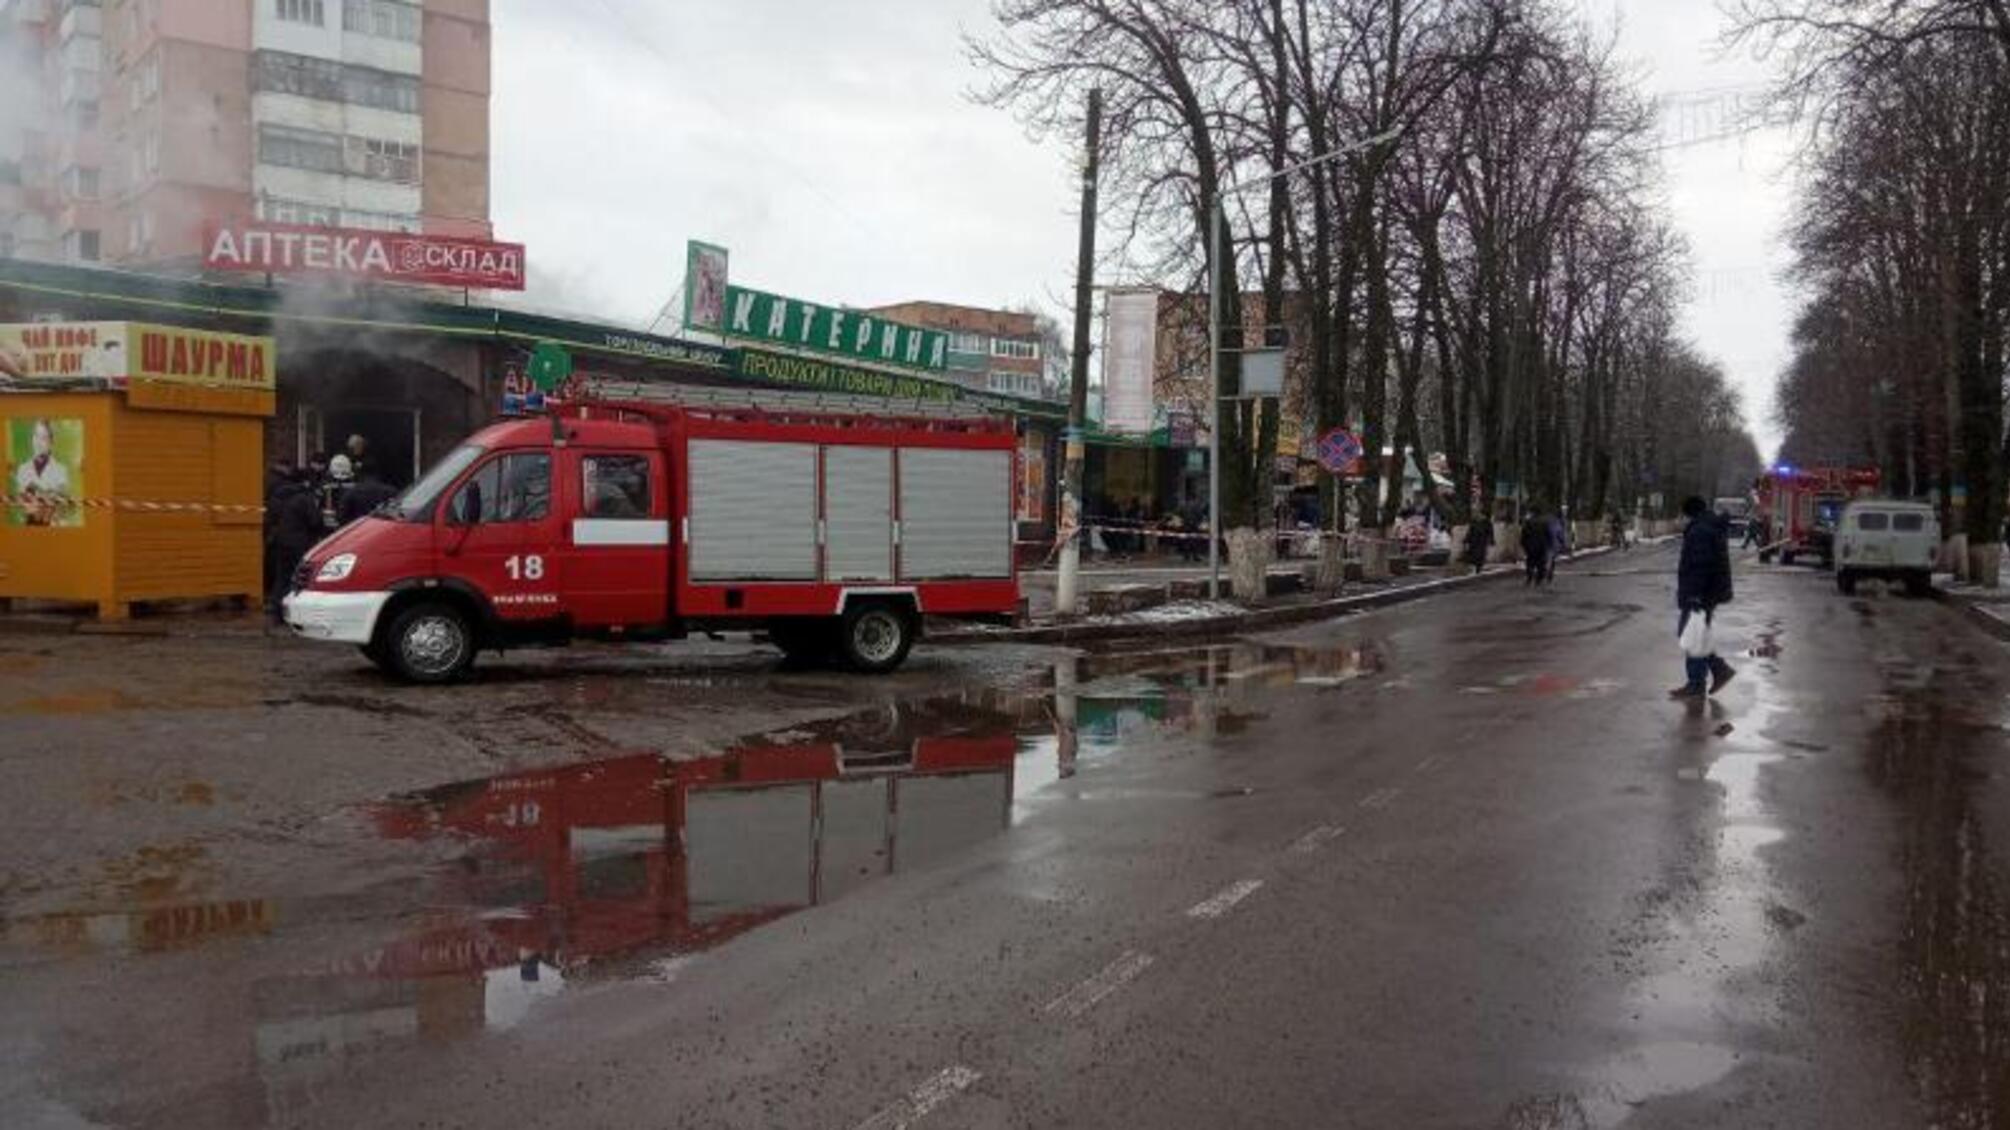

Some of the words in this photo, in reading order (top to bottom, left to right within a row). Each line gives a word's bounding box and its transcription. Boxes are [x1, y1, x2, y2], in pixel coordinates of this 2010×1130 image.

[209, 229, 392, 274] АПТЕКА
[426, 246, 517, 278] СКЛАД
[732, 291, 948, 369] КАТЕРИНА
[141, 332, 266, 382] ШАУРМА
[504, 554, 544, 580] 18
